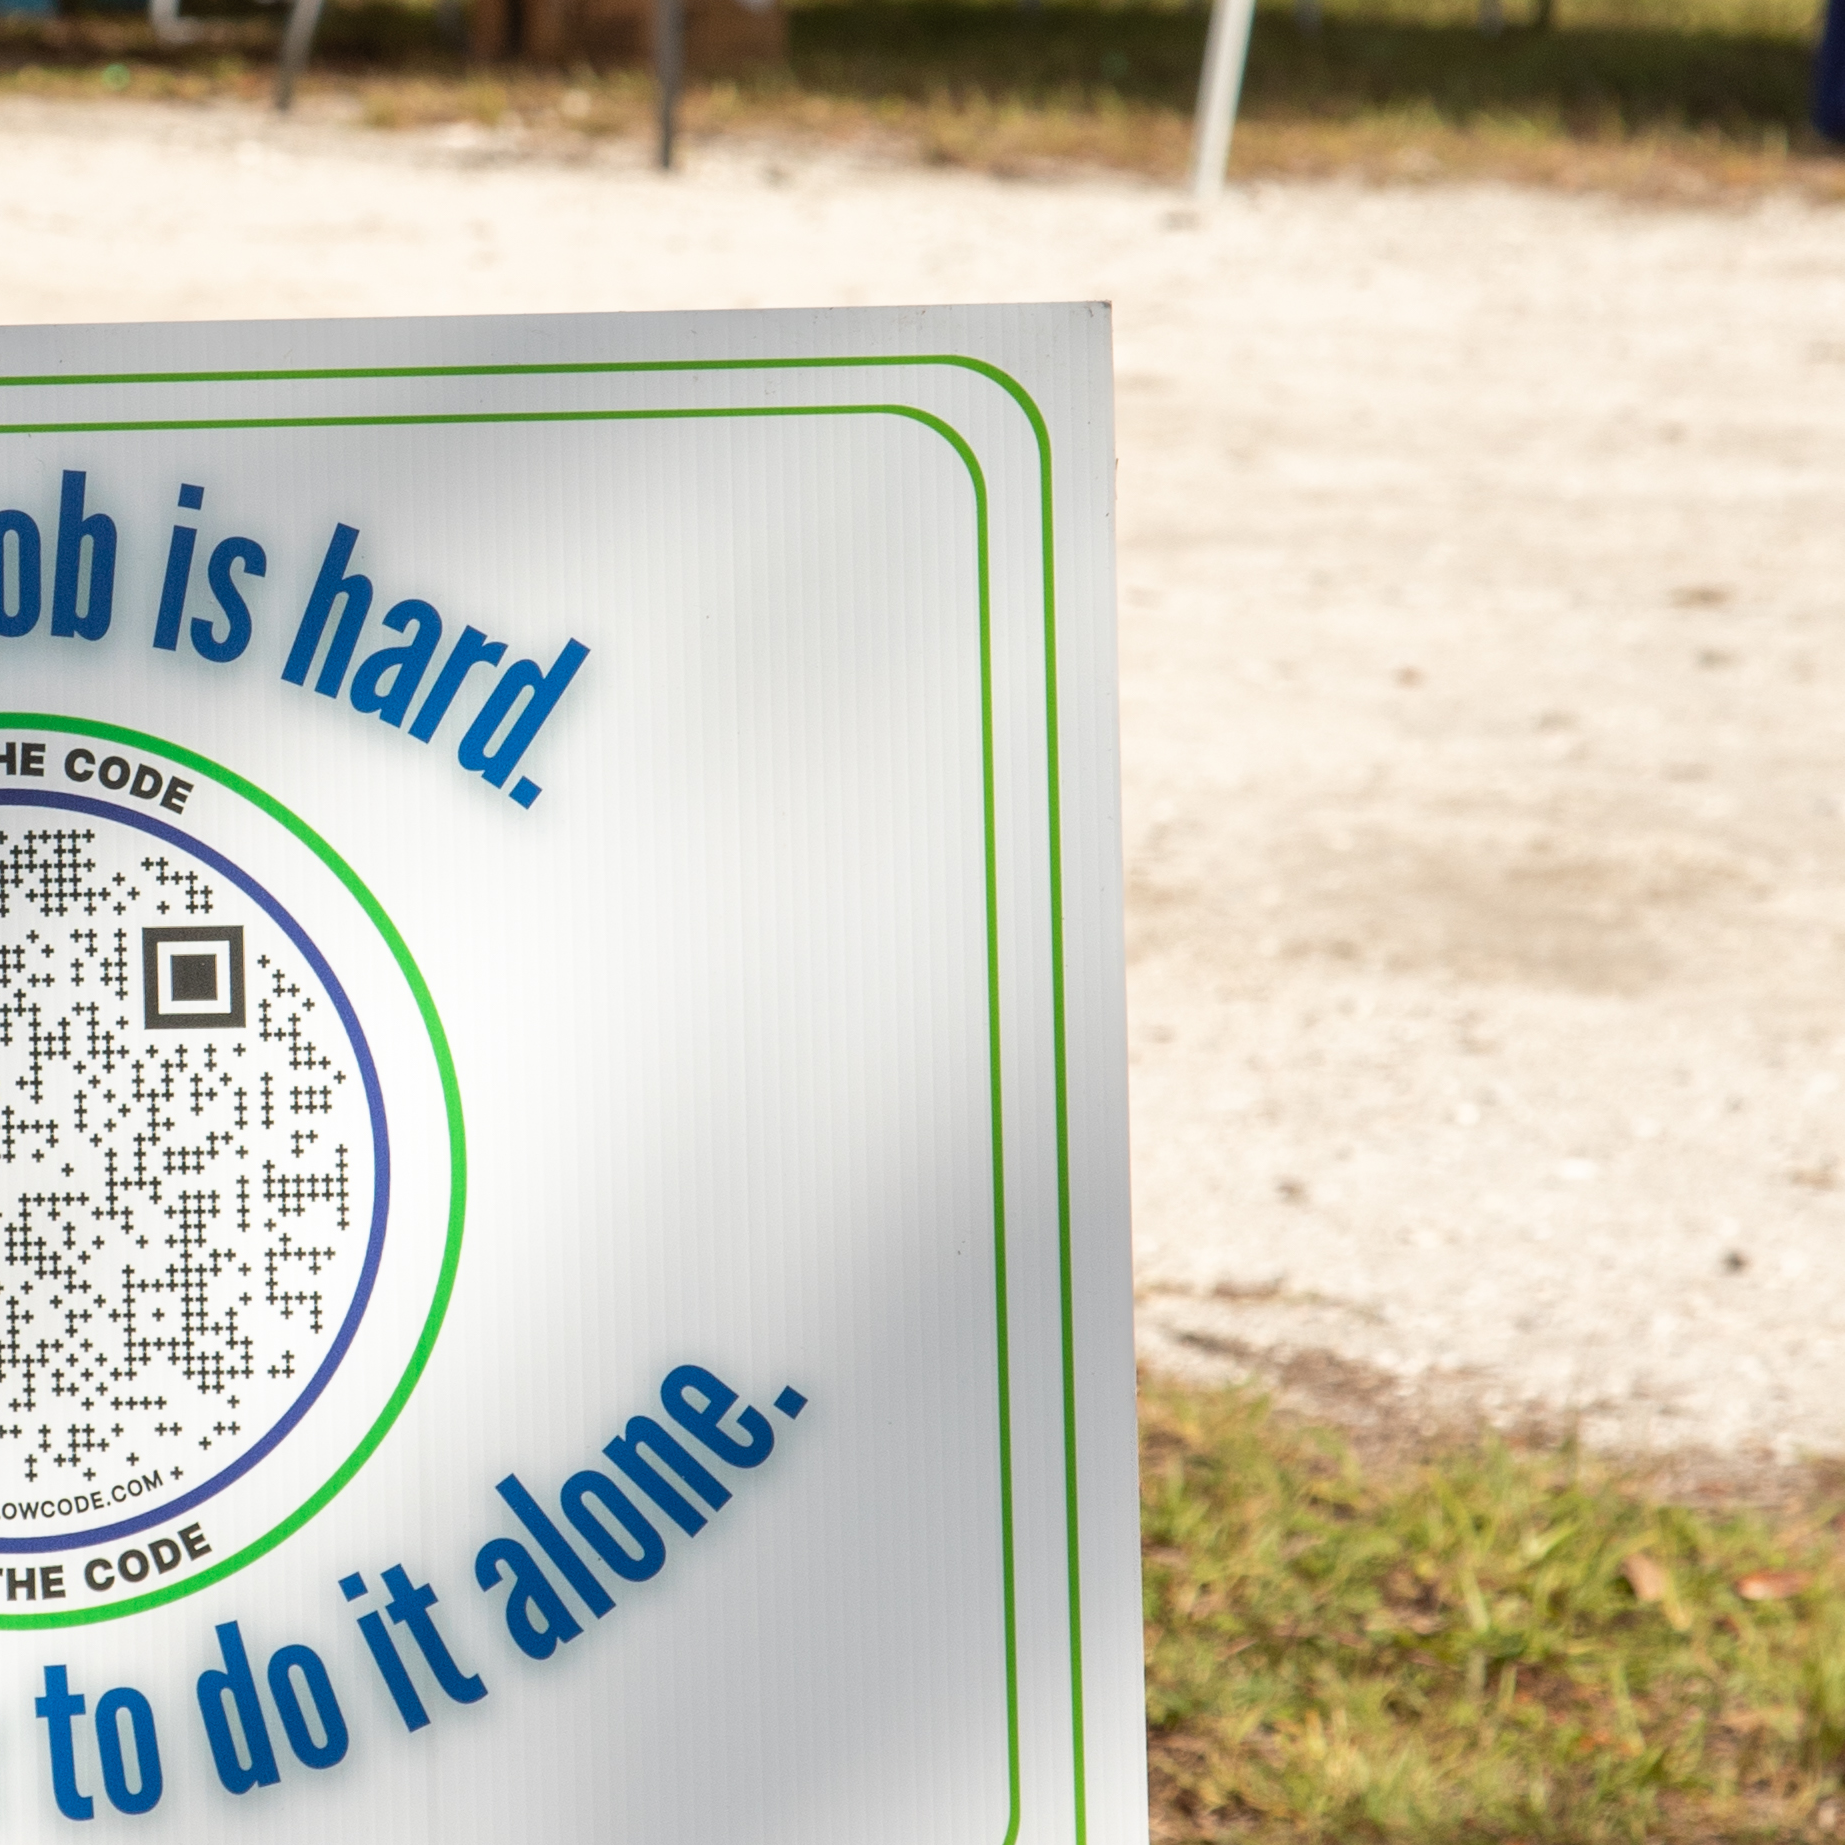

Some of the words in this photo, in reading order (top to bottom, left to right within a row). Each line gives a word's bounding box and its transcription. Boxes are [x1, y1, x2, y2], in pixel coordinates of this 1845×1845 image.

[152, 484, 267, 663] is
[280, 522, 591, 810] hard.
[63, 747, 195, 816] CODE
[35, 1664, 164, 1822] to
[196, 1619, 350, 1796] do
[337, 1563, 488, 1734] it
[474, 1363, 809, 1662] alone.
[83, 1521, 213, 1592] CODE
